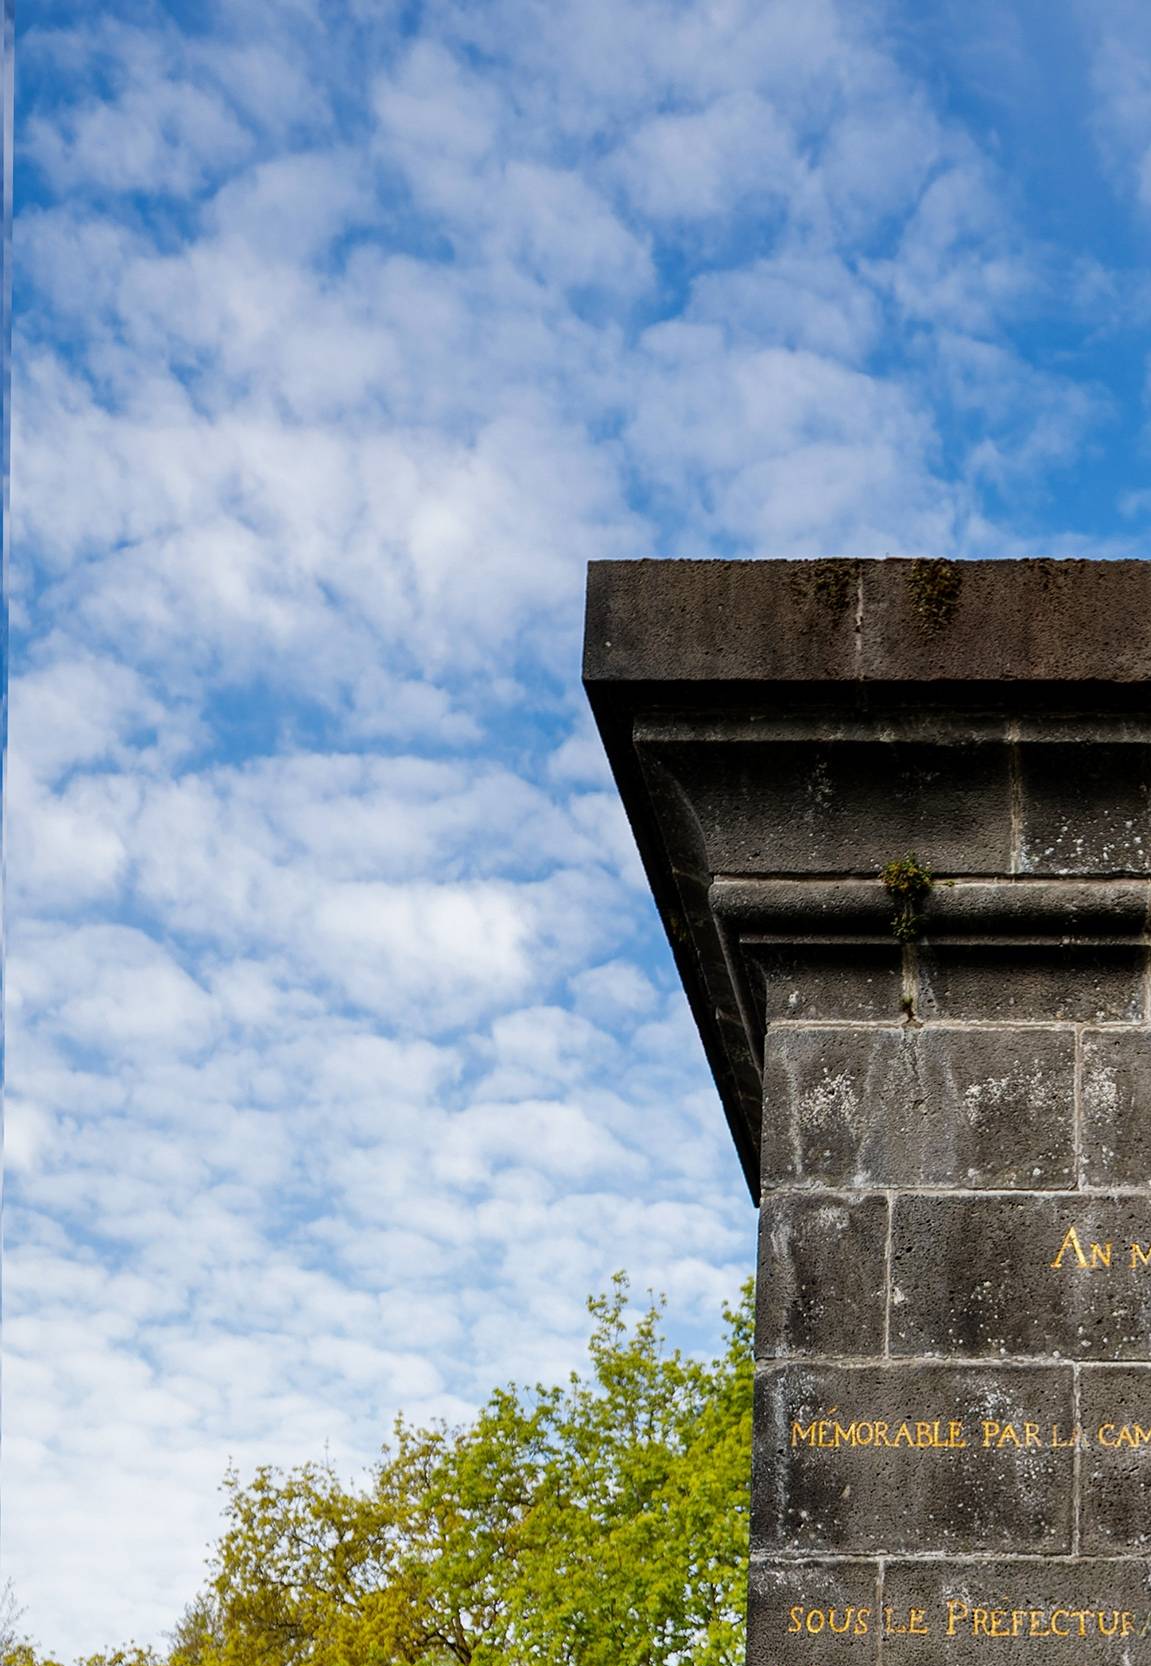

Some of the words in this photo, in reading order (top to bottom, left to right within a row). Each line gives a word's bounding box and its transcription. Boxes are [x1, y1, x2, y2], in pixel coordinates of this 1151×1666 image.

[1050, 1226, 1112, 1269] AN
[791, 1404, 967, 1448] MÉMORABLE
[982, 1420, 1042, 1449] PAR
[788, 1606, 869, 1634] SOUS
[885, 1607, 928, 1635] LE
